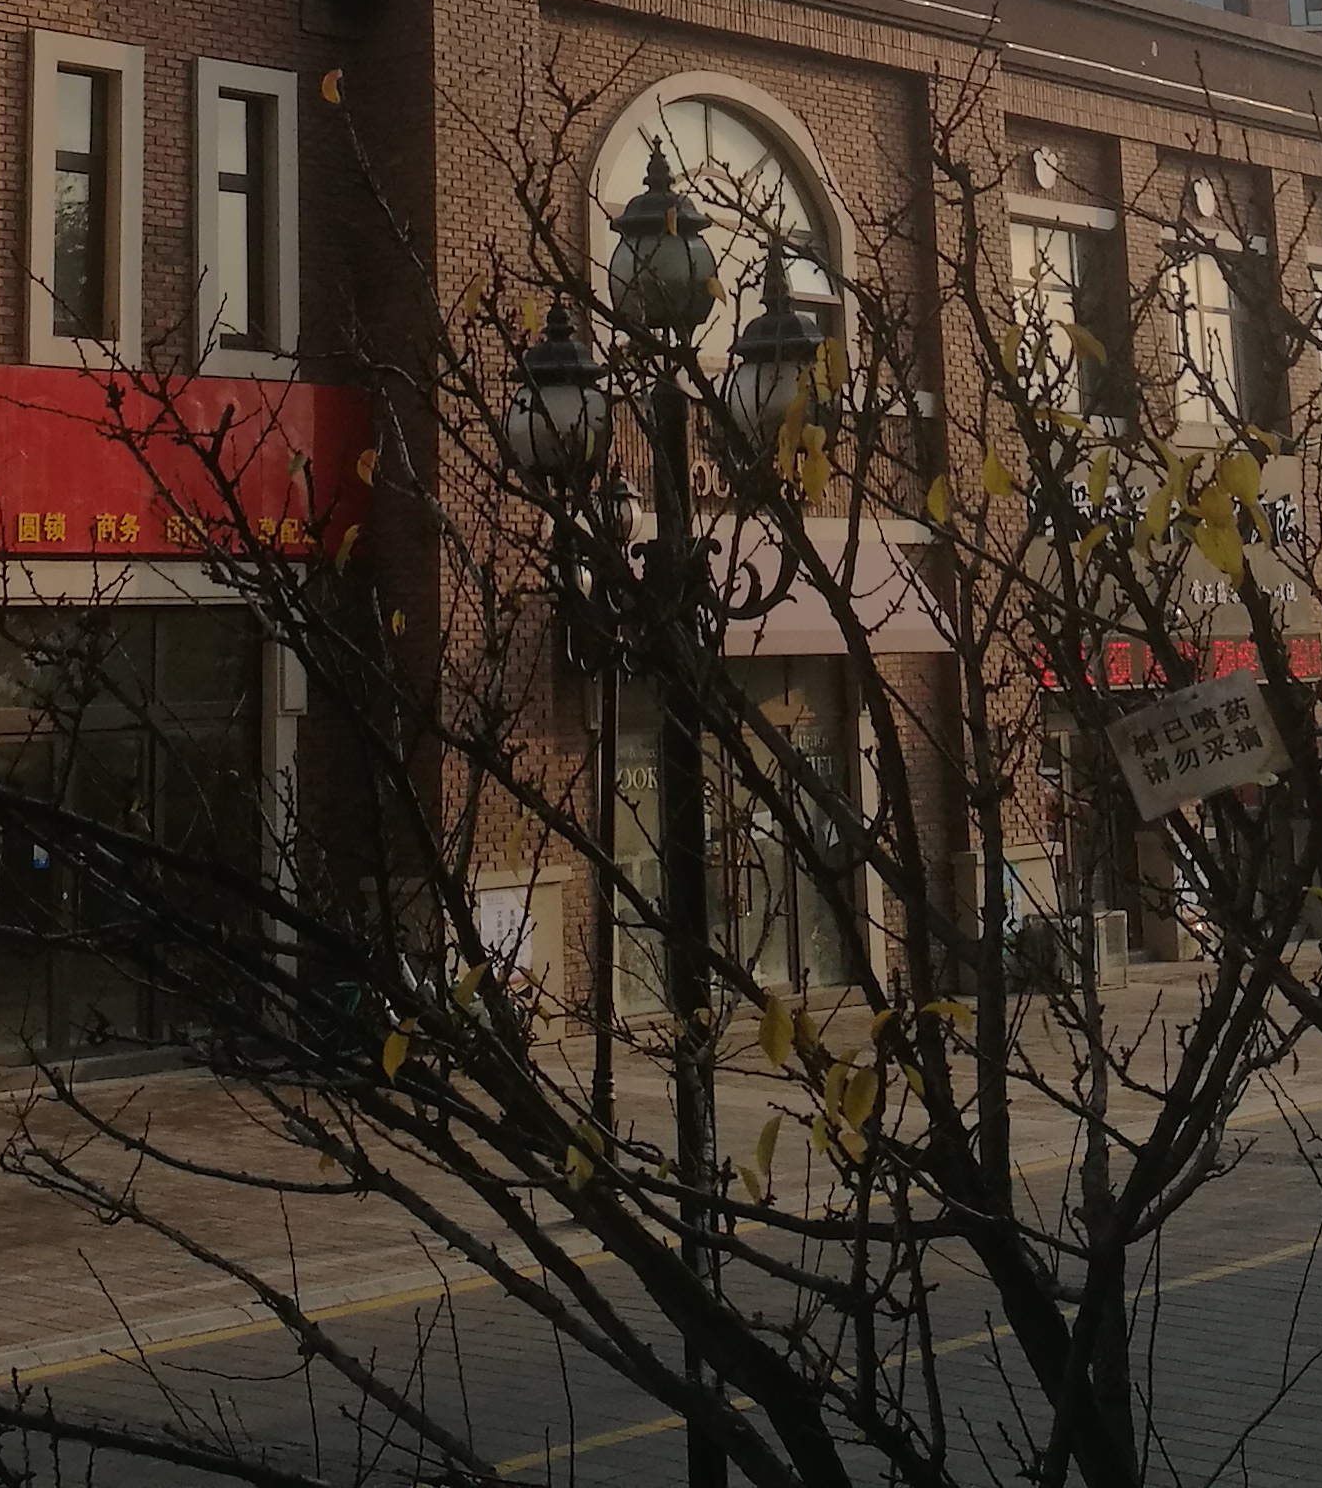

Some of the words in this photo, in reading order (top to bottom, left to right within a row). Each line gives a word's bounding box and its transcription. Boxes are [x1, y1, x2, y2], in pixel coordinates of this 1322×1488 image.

[18, 512, 66, 543] 圆锁
[95, 513, 141, 543] 商务
[1131, 696, 1251, 758] 树已喷药
[1143, 725, 1263, 786] 请勿采摘
